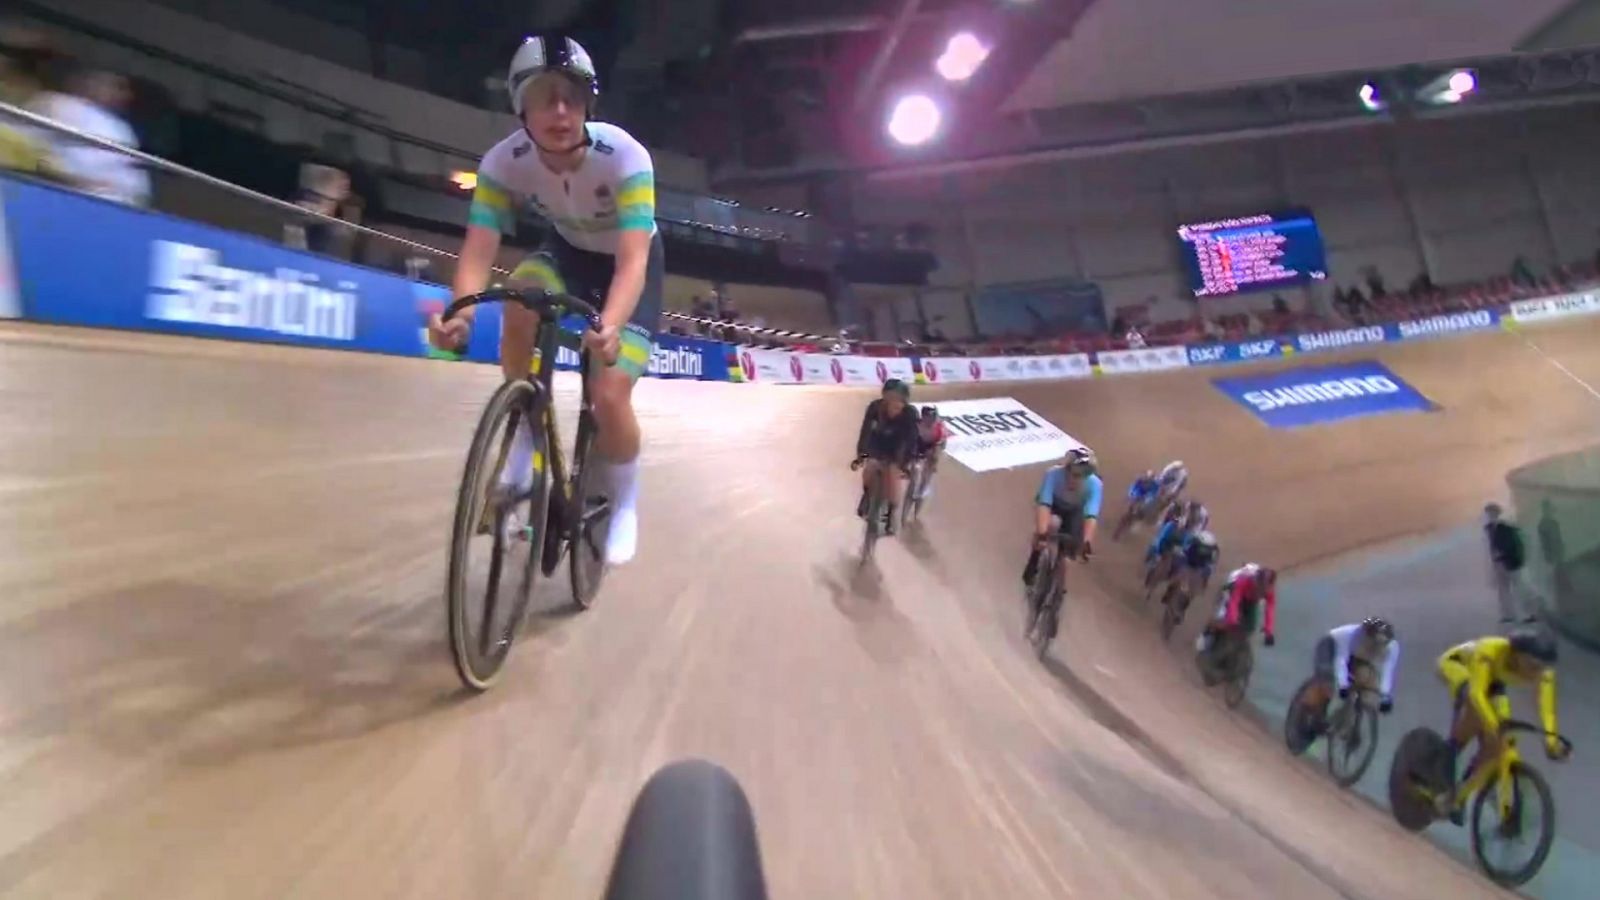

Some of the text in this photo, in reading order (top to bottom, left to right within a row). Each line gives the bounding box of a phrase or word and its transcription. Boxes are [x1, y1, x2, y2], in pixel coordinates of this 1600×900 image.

[146, 239, 358, 341] Santini
[1399, 310, 1491, 337] SHIMANO
[1238, 340, 1276, 357] SKF
[1298, 325, 1385, 351] SHIMANO
[648, 342, 703, 376] Santini
[1190, 346, 1227, 362] SKF
[1243, 375, 1400, 411] SHIMANO
[938, 410, 1042, 436] TISSOT
